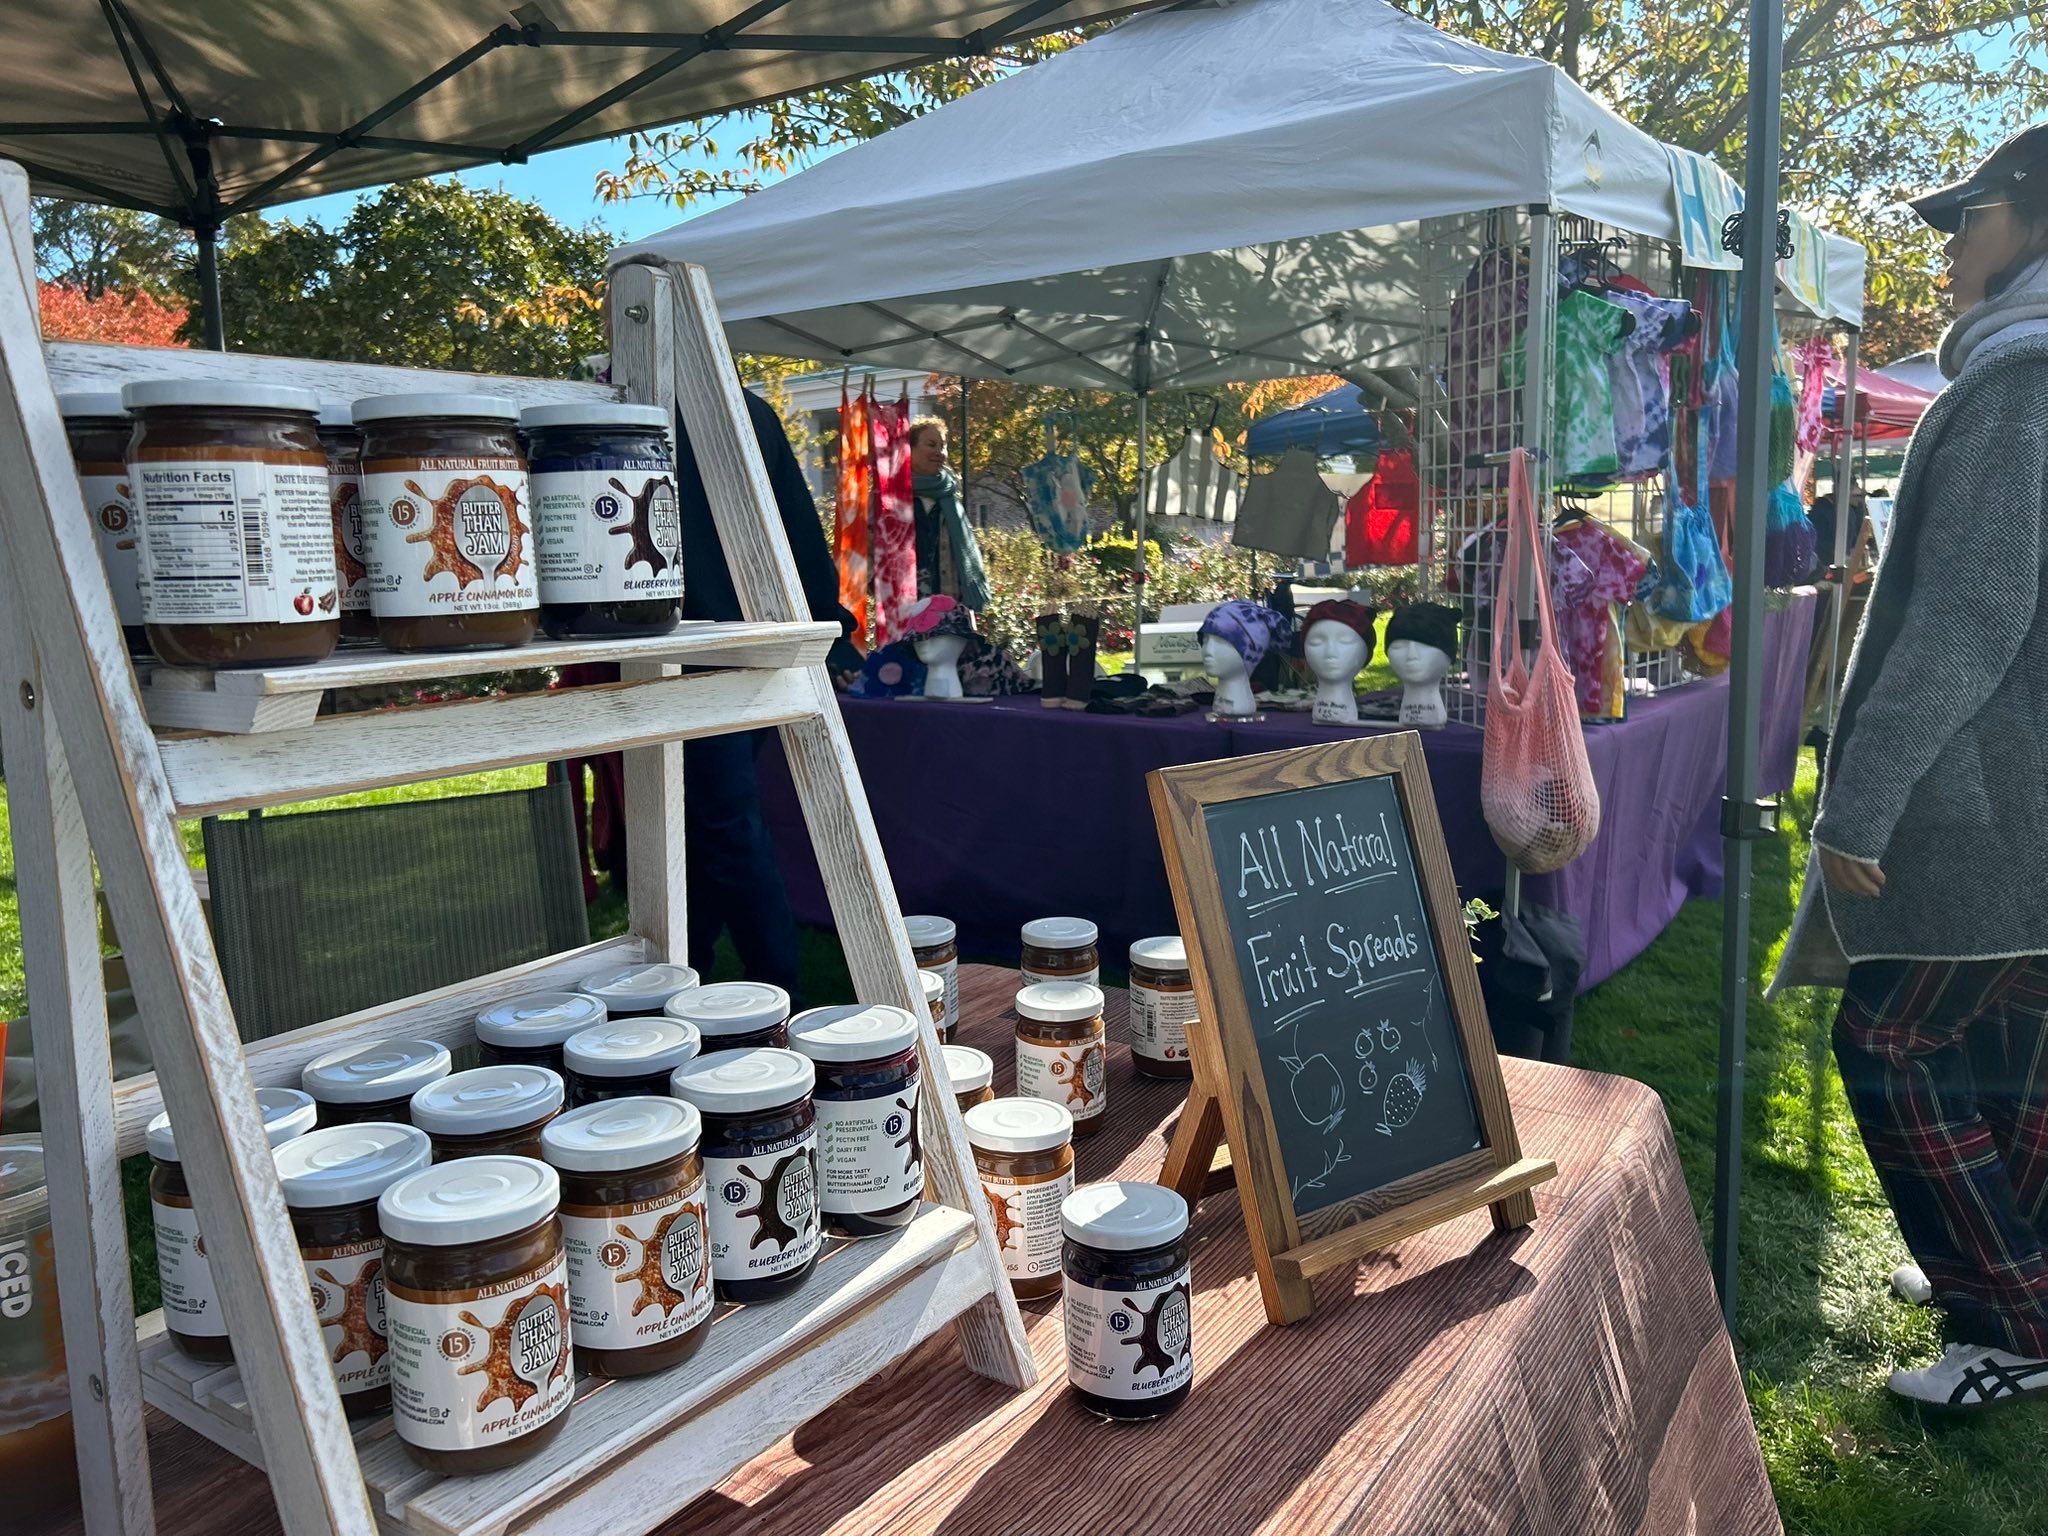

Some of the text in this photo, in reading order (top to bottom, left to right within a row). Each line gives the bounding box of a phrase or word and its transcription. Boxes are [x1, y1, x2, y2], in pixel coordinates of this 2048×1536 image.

[420, 459, 520, 470] ALL NATURAL FRUIT BUTTER
[623, 460, 637, 470] ALL
[637, 460, 663, 470] NATURAL
[143, 472, 231, 484] Nutrition Facts
[274, 474, 296, 484] TASTE
[219, 510, 235, 521] 15
[397, 505, 410, 521] 15
[461, 502, 501, 515] BUTTER
[601, 500, 612, 515] 15
[107, 510, 121, 527] 15
[462, 515, 502, 533] THAN
[466, 533, 505, 555] JAM
[623, 579, 669, 590] BLUEBERRY
[429, 592, 464, 603] APPLE
[466, 589, 516, 601] CINNAMON
[454, 603, 469, 612] NET
[1238, 812, 1398, 898] All Natural
[1246, 913, 1418, 1008] Fruit Spreads
[1054, 1064, 1062, 1073] 15
[835, 1124, 878, 1133] PRESERVATIVES
[844, 1118, 875, 1126] ARTIFICIAL
[888, 1118, 899, 1132] 15
[752, 1146, 767, 1156] ALL
[766, 1136, 796, 1154] NATURAL
[992, 1176, 1015, 1185] BUTTER
[728, 1186, 741, 1200] 15
[783, 1178, 811, 1201] THAN
[827, 1185, 886, 1194] BUTTERTHANJAM.COM
[632, 1203, 648, 1215] ALL
[649, 1193, 681, 1212] NATURAL
[668, 1222, 698, 1247] BUTTER
[331, 1238, 386, 1259] ALL NATURA
[607, 1247, 620, 1263] 15
[668, 1236, 699, 1264] THAN
[748, 1247, 798, 1268] BLUEBERRY
[671, 1253, 700, 1284] JAM
[770, 1264, 783, 1273] NET
[0, 1239, 32, 1319] ICED
[477, 1263, 552, 1300] ALL NATURAL FRUIT
[1135, 1282, 1148, 1291] ALL
[1148, 1274, 1173, 1289] NATURAL
[518, 1304, 555, 1333] BUTTER
[636, 1318, 669, 1336] APPLE
[1114, 1316, 1125, 1329] 15
[1163, 1309, 1185, 1332] THAN
[519, 1318, 556, 1351] THAN
[659, 1328, 672, 1339] NET
[448, 1336, 463, 1354] 15
[521, 1337, 558, 1374] JAM
[338, 1366, 376, 1384] APPLE
[1131, 1373, 1175, 1391] BLUEBERRY
[481, 1389, 565, 1434] APPLE CINNAMON
[508, 1426, 522, 1437] NET
